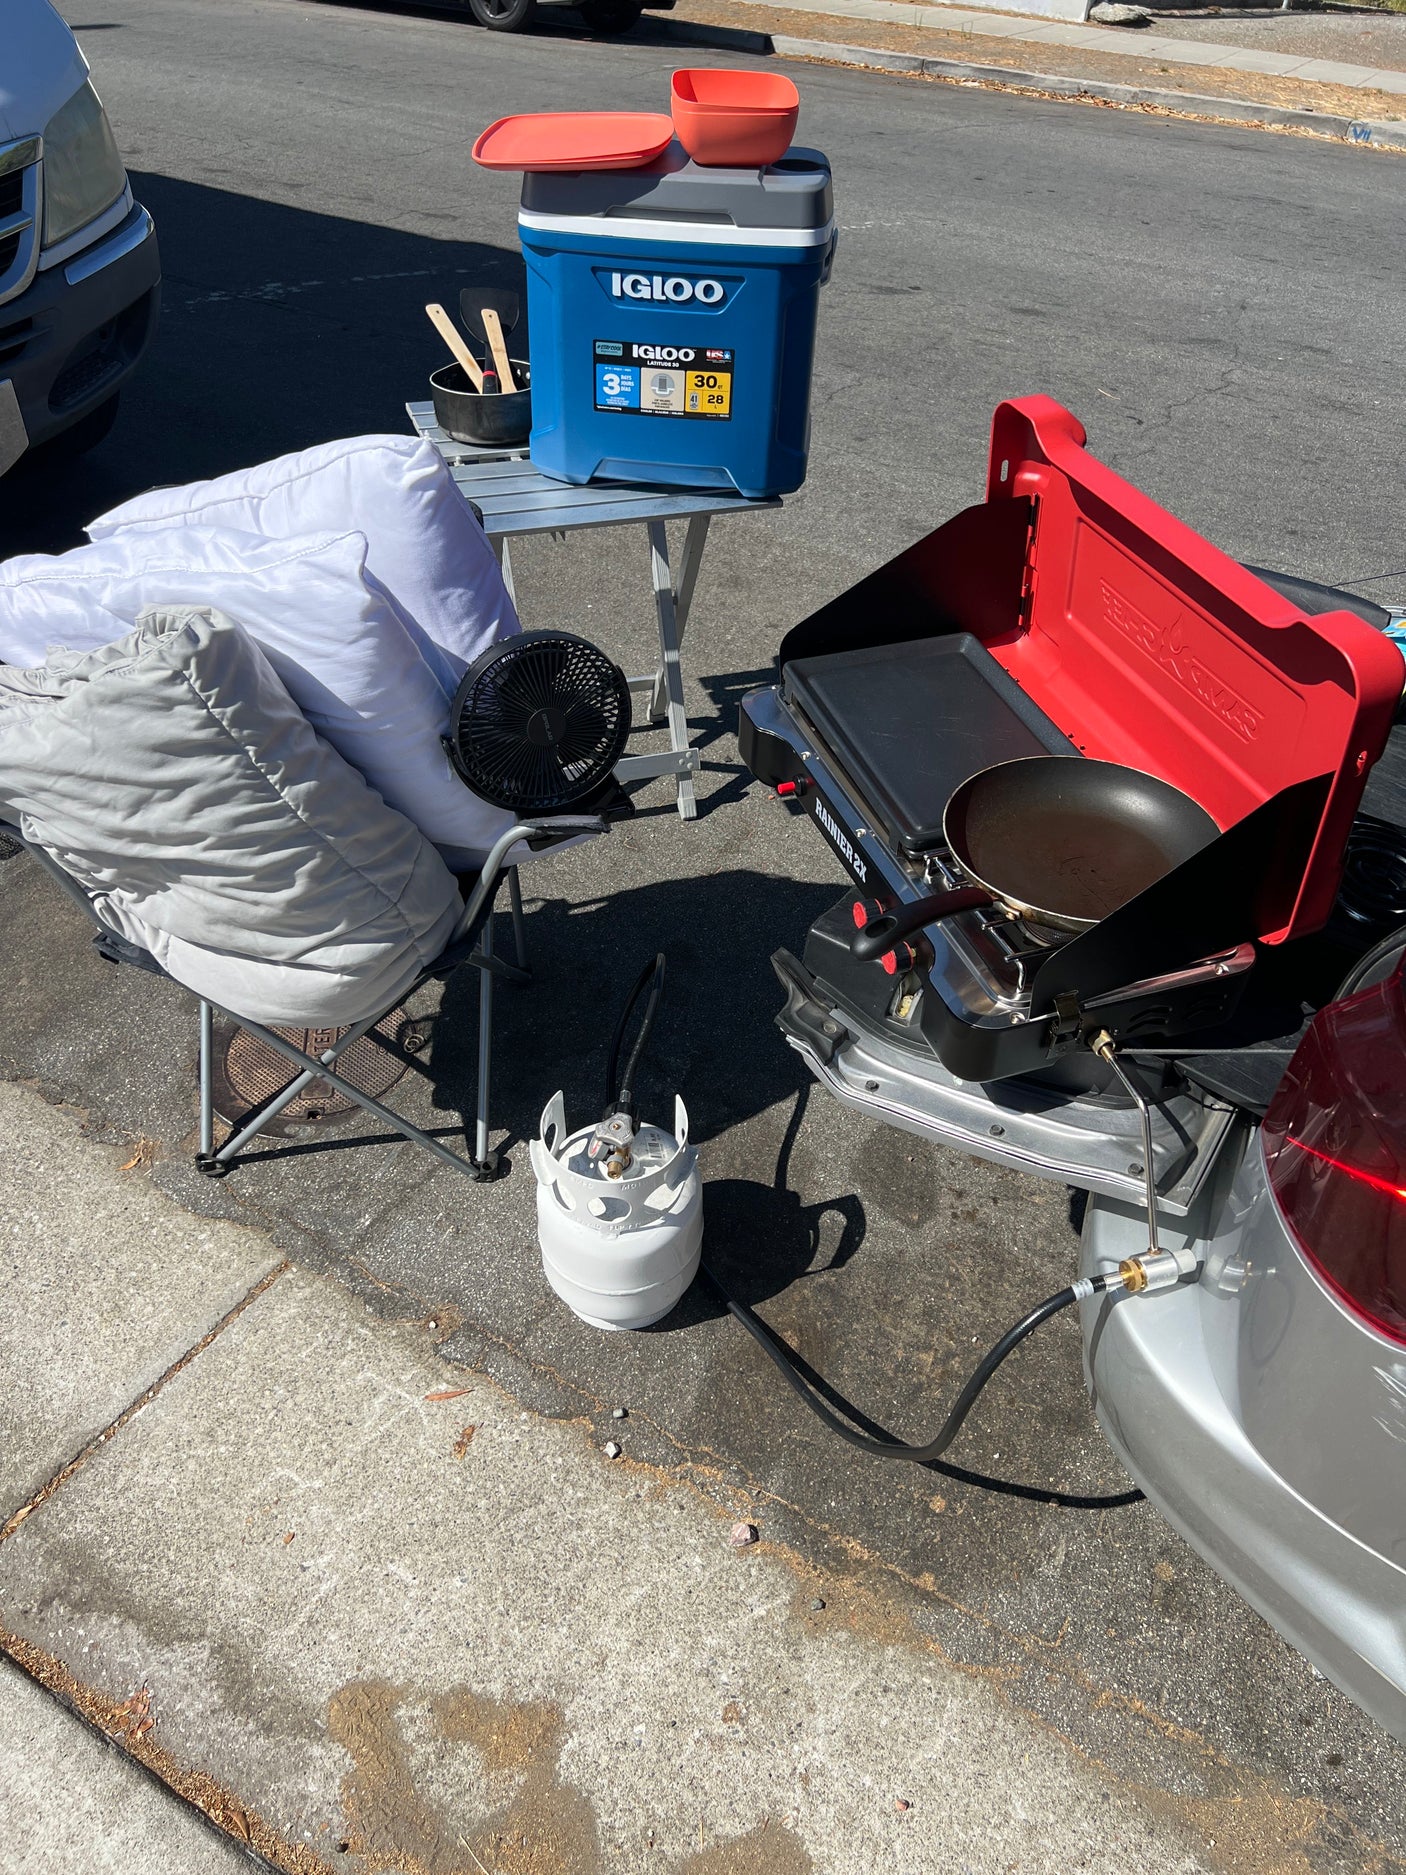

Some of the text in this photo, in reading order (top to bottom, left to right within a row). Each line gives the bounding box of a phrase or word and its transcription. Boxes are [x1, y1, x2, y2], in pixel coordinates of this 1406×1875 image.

[612, 272, 724, 303] IGLOO
[632, 344, 695, 362] IGLOO
[603, 373, 621, 395] 3
[694, 375, 717, 389] 30
[690, 395, 698, 403] 41
[708, 394, 724, 405] 28
[815, 797, 867, 883] RAINIER 2X
